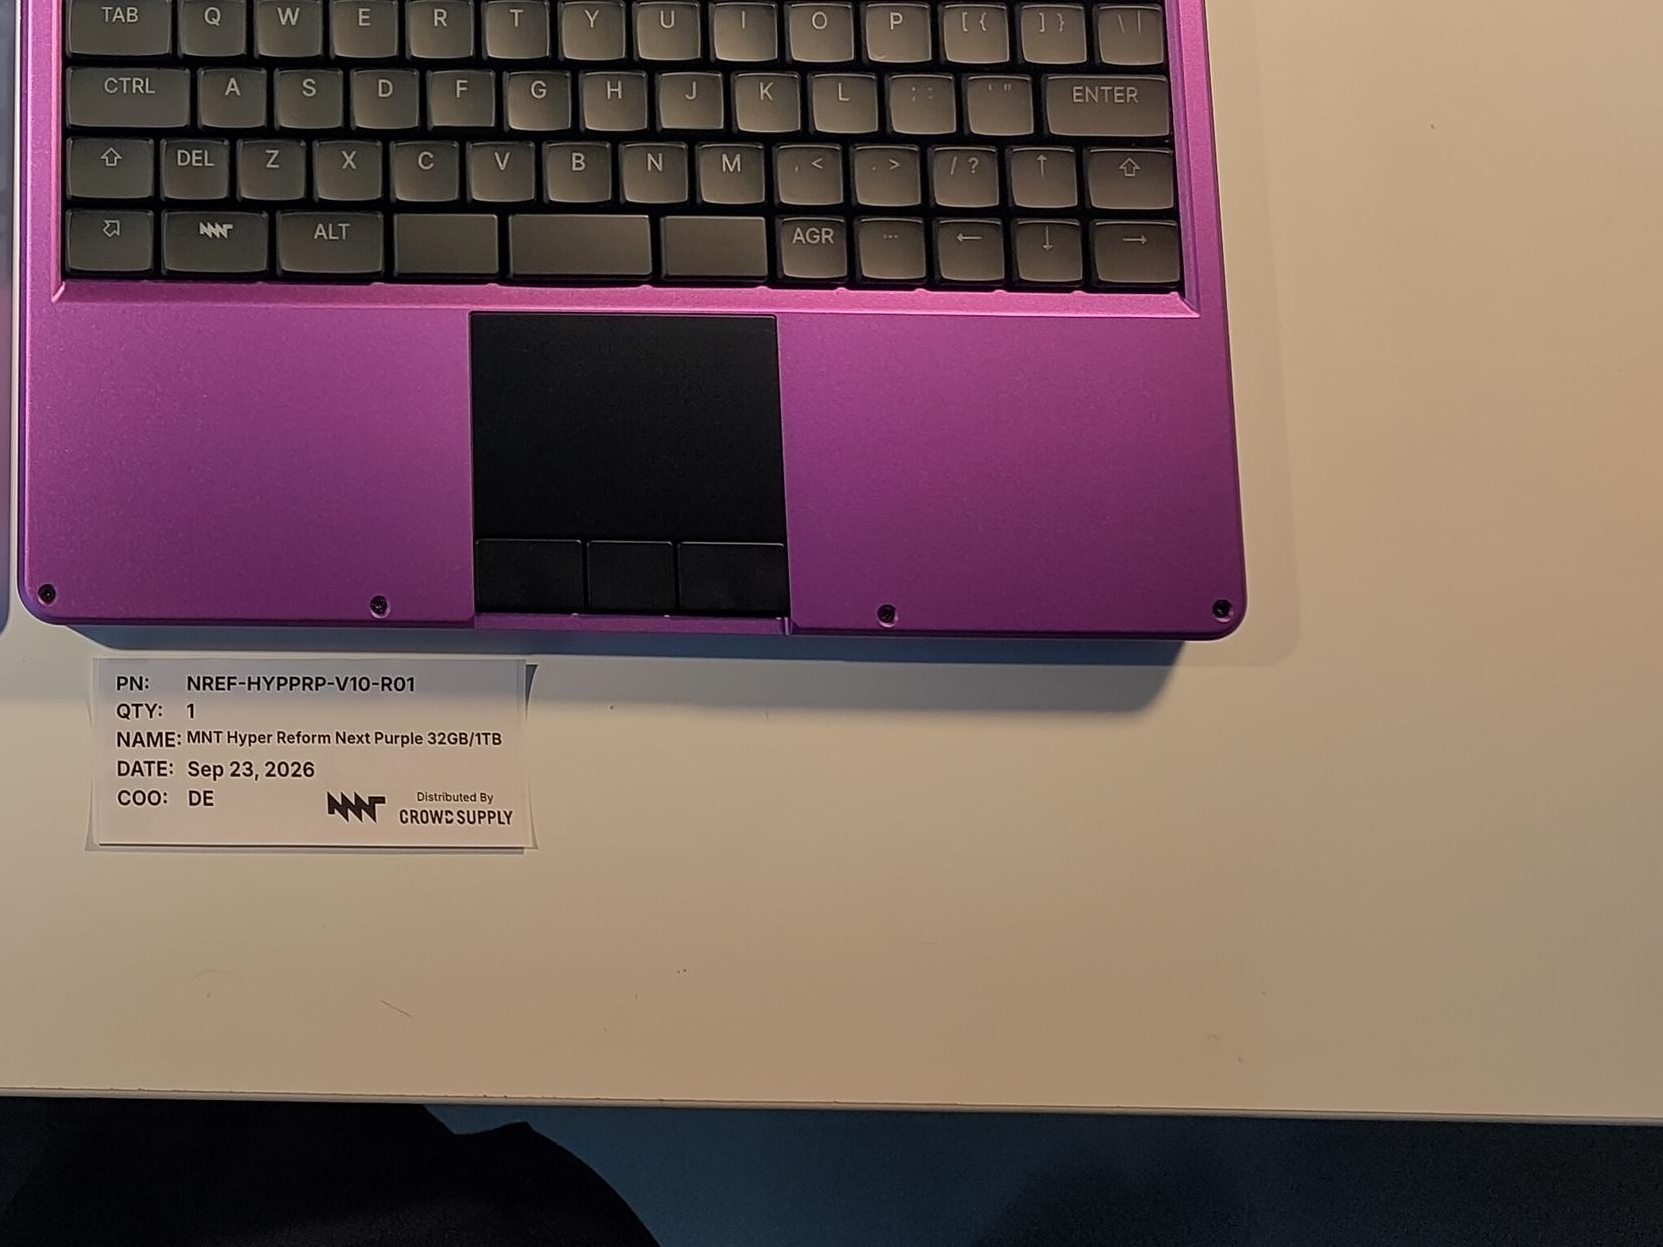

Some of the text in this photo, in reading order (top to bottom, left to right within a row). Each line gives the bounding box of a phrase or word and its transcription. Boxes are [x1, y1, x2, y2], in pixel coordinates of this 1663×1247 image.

[102, 7, 138, 23] TAB
[204, 7, 221, 27] Q
[277, 8, 299, 26] W
[359, 9, 370, 26] E
[434, 9, 447, 27] R
[509, 10, 523, 27] T
[584, 10, 598, 28] Y
[661, 11, 675, 29] U
[890, 12, 903, 30] P
[105, 77, 155, 95] CTRL
[226, 78, 240, 96] A
[303, 79, 316, 97] S
[378, 80, 393, 97] D
[456, 80, 467, 97] F
[531, 80, 546, 98] G
[607, 81, 621, 99] H
[685, 82, 696, 101] J
[760, 82, 772, 101] K
[839, 83, 849, 101] L
[1073, 86, 1138, 103] ENTER
[178, 150, 214, 167] DEL
[266, 150, 279, 168] Z
[342, 151, 356, 169] X
[418, 152, 434, 170] C
[495, 152, 509, 170] V
[572, 153, 585, 171] B
[648, 154, 663, 172] N
[722, 154, 741, 173] M
[314, 223, 350, 241] ALT
[792, 228, 834, 245] AGR
[117, 676, 415, 692] PN: NREF-HYPPRP-V10-R01
[117, 703, 195, 720] QTY: 1
[117, 731, 502, 748] NAME: MNT Hyper Reform Next Purple 32GB/1TB
[117, 761, 315, 781] DATE: Sep 23, 2026
[117, 790, 214, 806] COO: DE
[417, 792, 494, 805] Distributed By
[456, 810, 512, 826] SUPPLY
